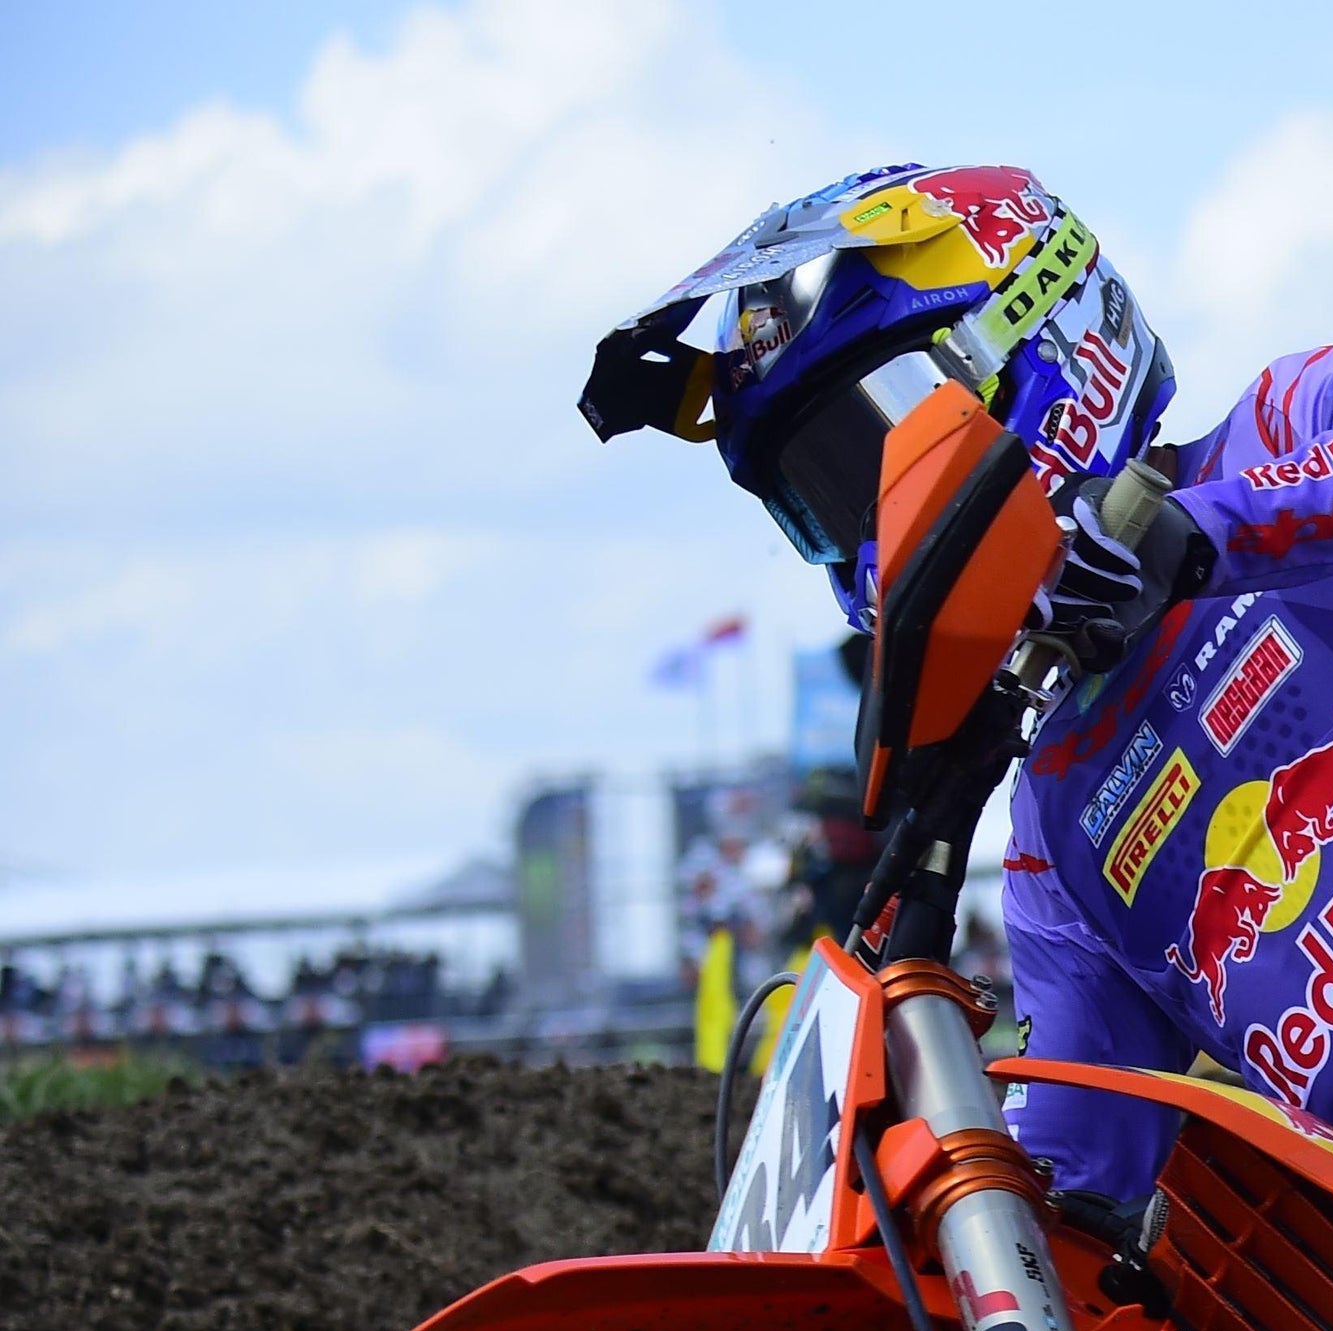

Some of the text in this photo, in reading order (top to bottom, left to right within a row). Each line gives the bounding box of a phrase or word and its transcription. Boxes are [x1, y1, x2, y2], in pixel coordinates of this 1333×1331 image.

[911, 288, 969, 309] AIROH
[1105, 283, 1127, 330] HVG
[753, 321, 793, 360] Bull
[1043, 330, 1128, 464] Bull
[1243, 444, 1331, 488] Red
[1082, 724, 1160, 837] GALVIN
[1109, 763, 1191, 894] PIRELLI
